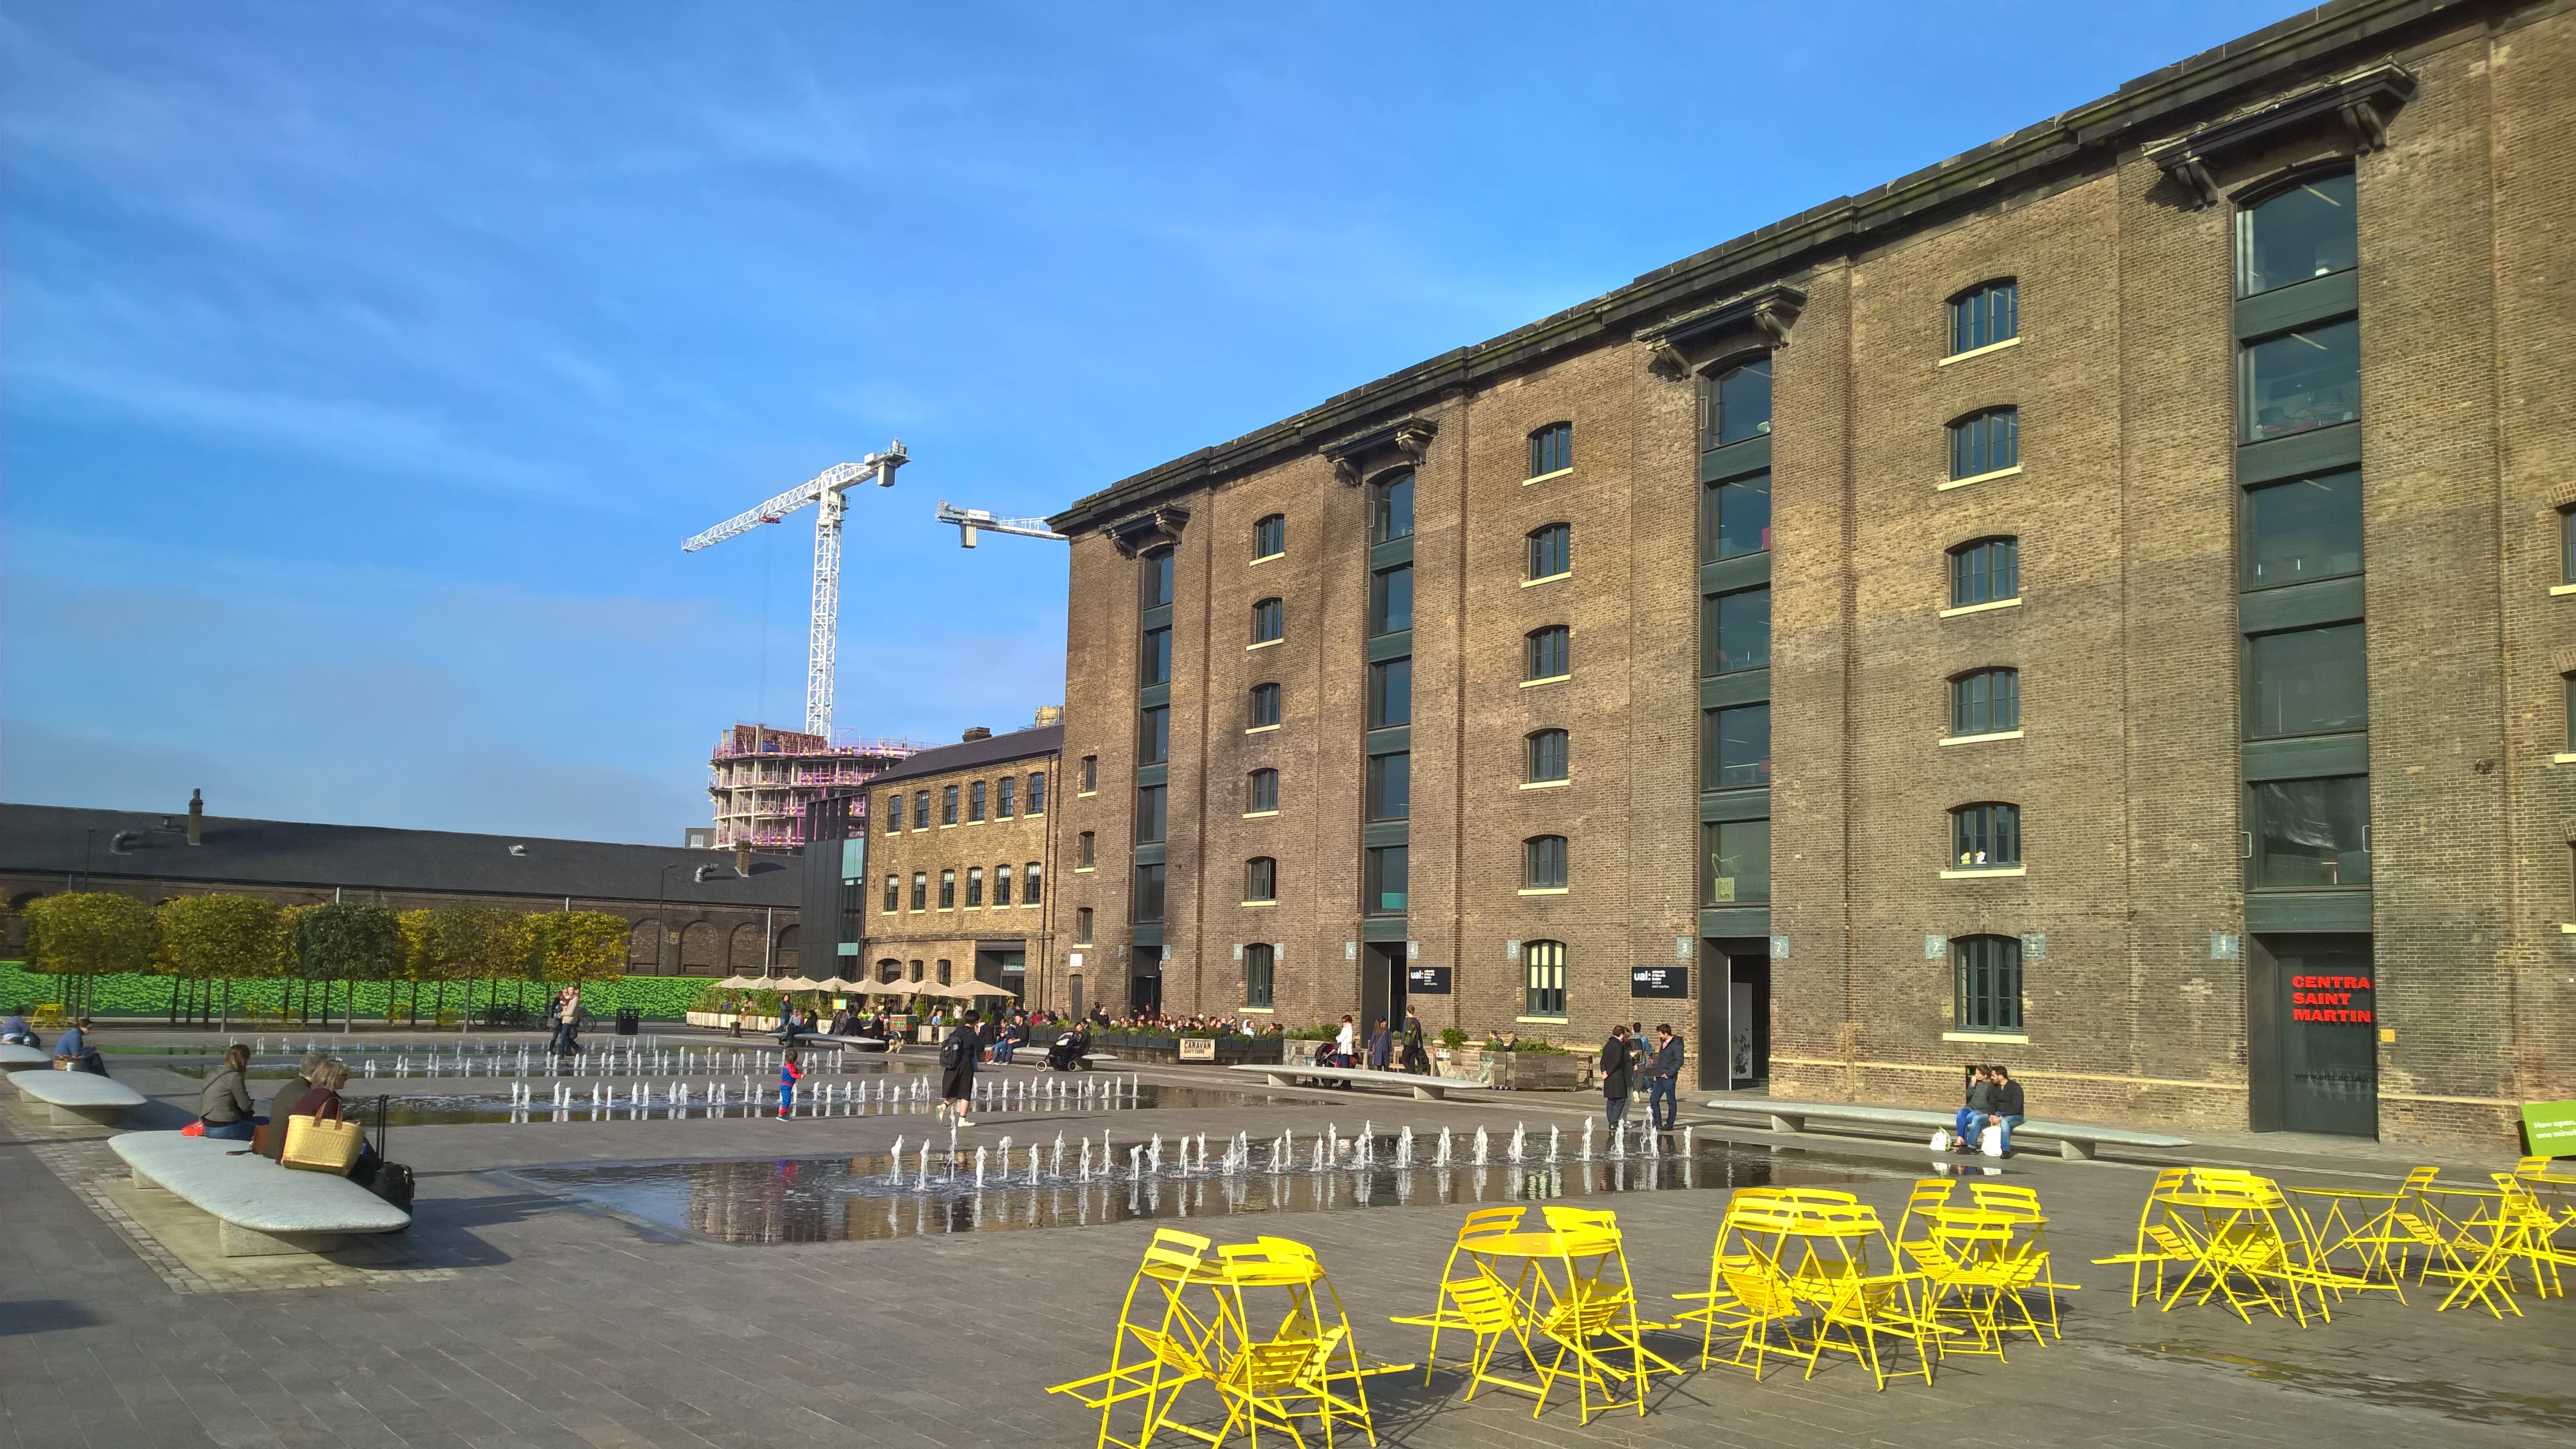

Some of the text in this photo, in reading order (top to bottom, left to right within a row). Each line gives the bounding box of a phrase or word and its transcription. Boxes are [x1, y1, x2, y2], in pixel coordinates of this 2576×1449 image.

[1511, 945, 1516, 954] 3
[1682, 943, 1687, 952] 3
[1411, 969, 1424, 979] ual:
[1634, 970, 1651, 981] ual:
[2293, 992, 2352, 1005] SAINT
[1184, 1041, 1211, 1049] CARAVAN
